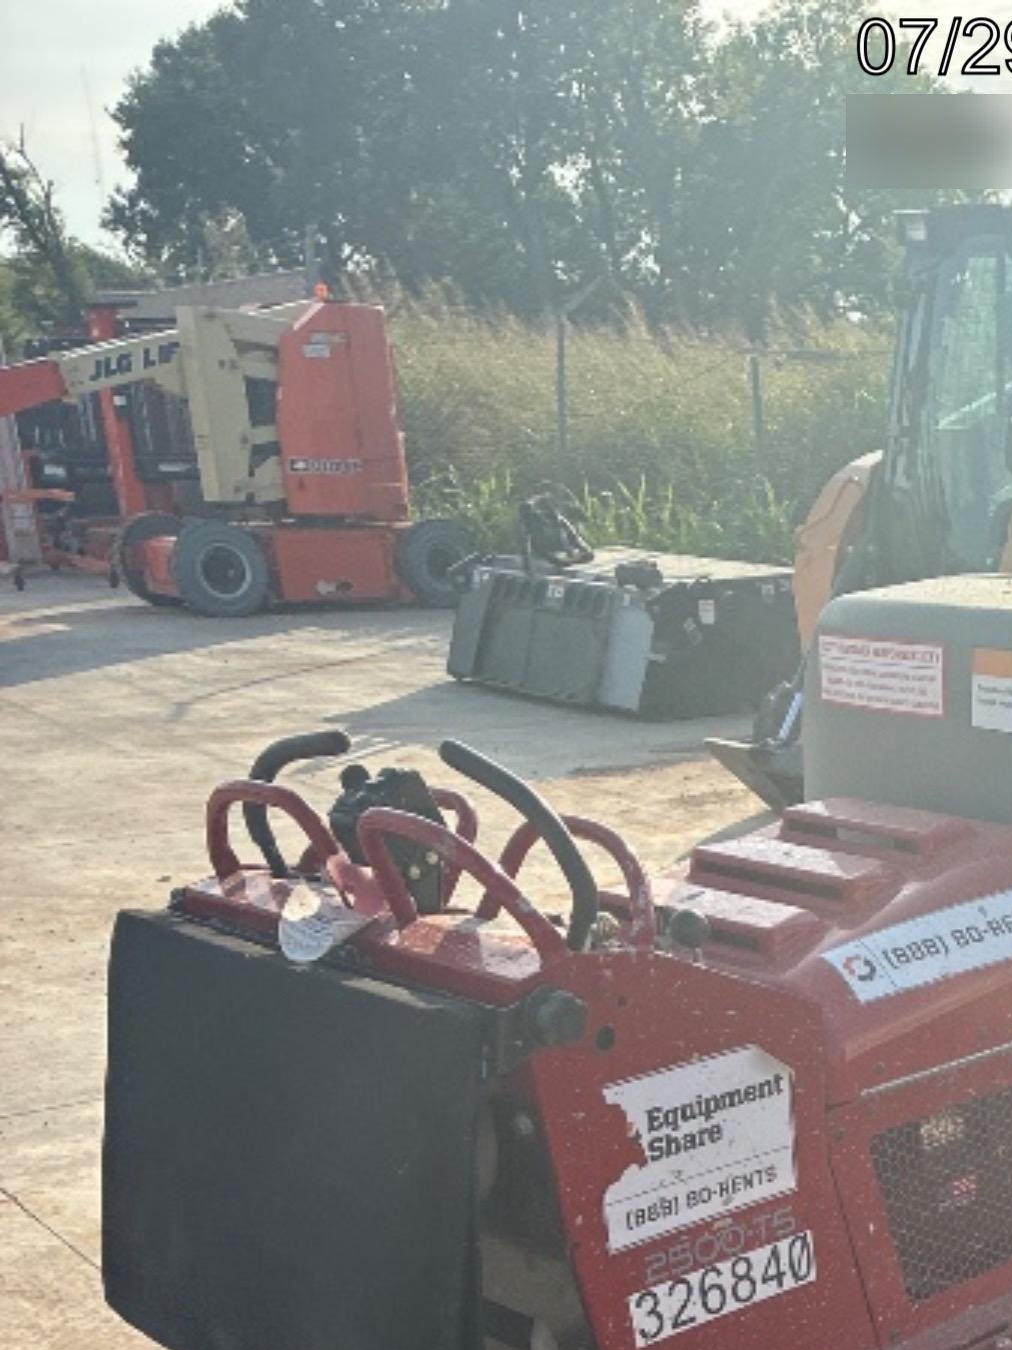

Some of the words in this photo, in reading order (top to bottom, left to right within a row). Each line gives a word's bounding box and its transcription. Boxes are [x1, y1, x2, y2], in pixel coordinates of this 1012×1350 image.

[89, 351, 133, 381] JLG
[882, 935, 950, 970] (888)
[645, 1073, 783, 1134] Equipment
[648, 1122, 724, 1163] Share
[625, 1196, 679, 1231] (888)
[635, 1233, 811, 1340] 326840
